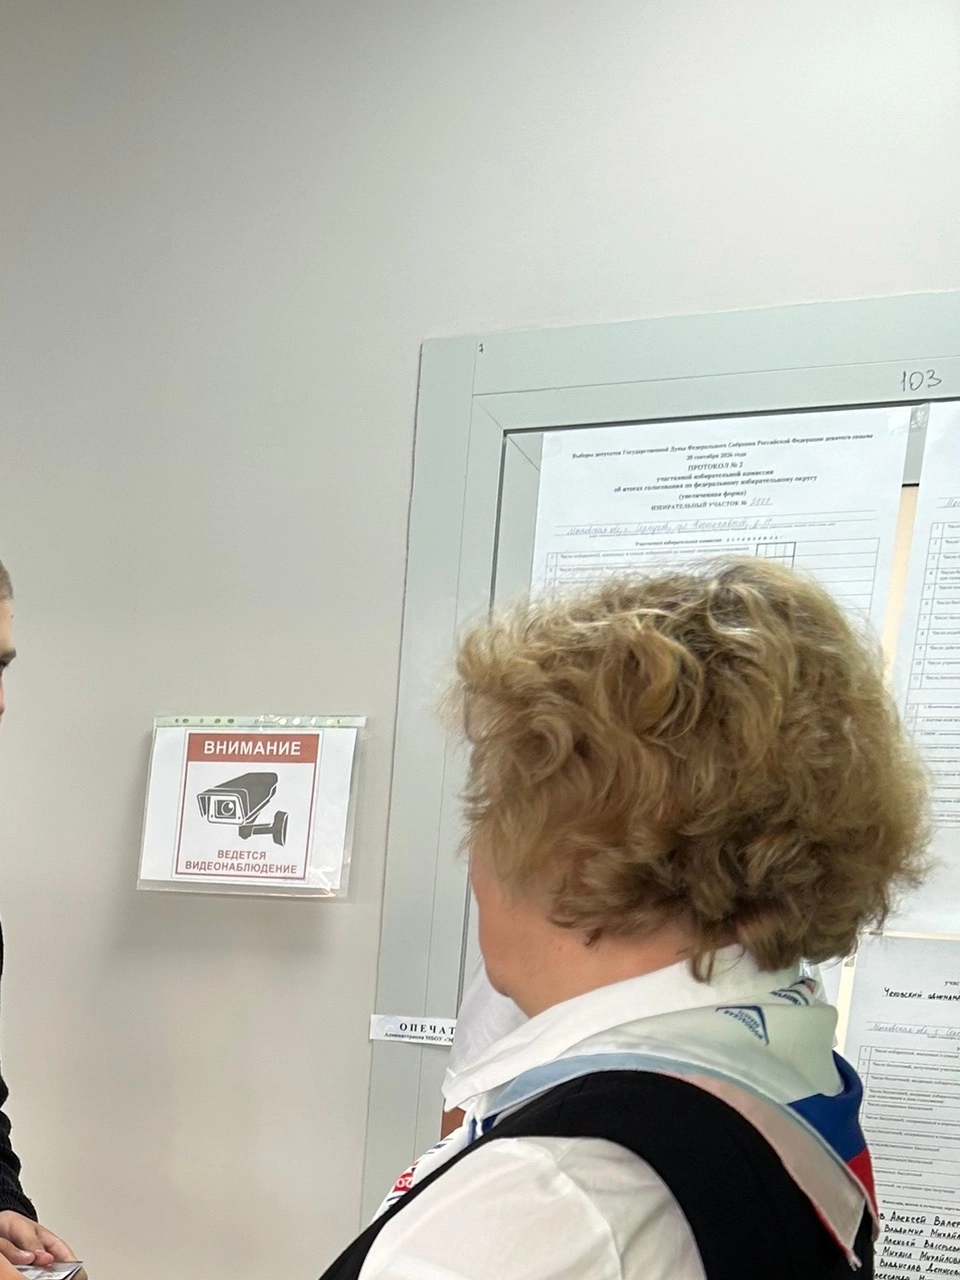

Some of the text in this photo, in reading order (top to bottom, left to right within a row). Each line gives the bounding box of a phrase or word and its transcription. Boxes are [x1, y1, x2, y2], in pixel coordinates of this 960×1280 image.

[901, 369, 942, 391] 103
[688, 462, 729, 472] ПРОТОКОЛ
[651, 501, 707, 511] ИЗБИРАТЕЛЬНЫЙ
[708, 500, 739, 508] УЧАСТОК
[203, 740, 302, 756] ВНИМАНИЕ
[217, 850, 266, 860] ВЕДЕТСЯ
[185, 860, 297, 874] ВИДЕОНАБЛЮДЕНИЕ
[890, 1211, 927, 1225] Алексей
[884, 1224, 924, 1236] Владимир
[882, 1246, 912, 1259] Михаил
[880, 1258, 921, 1272] Владислав
